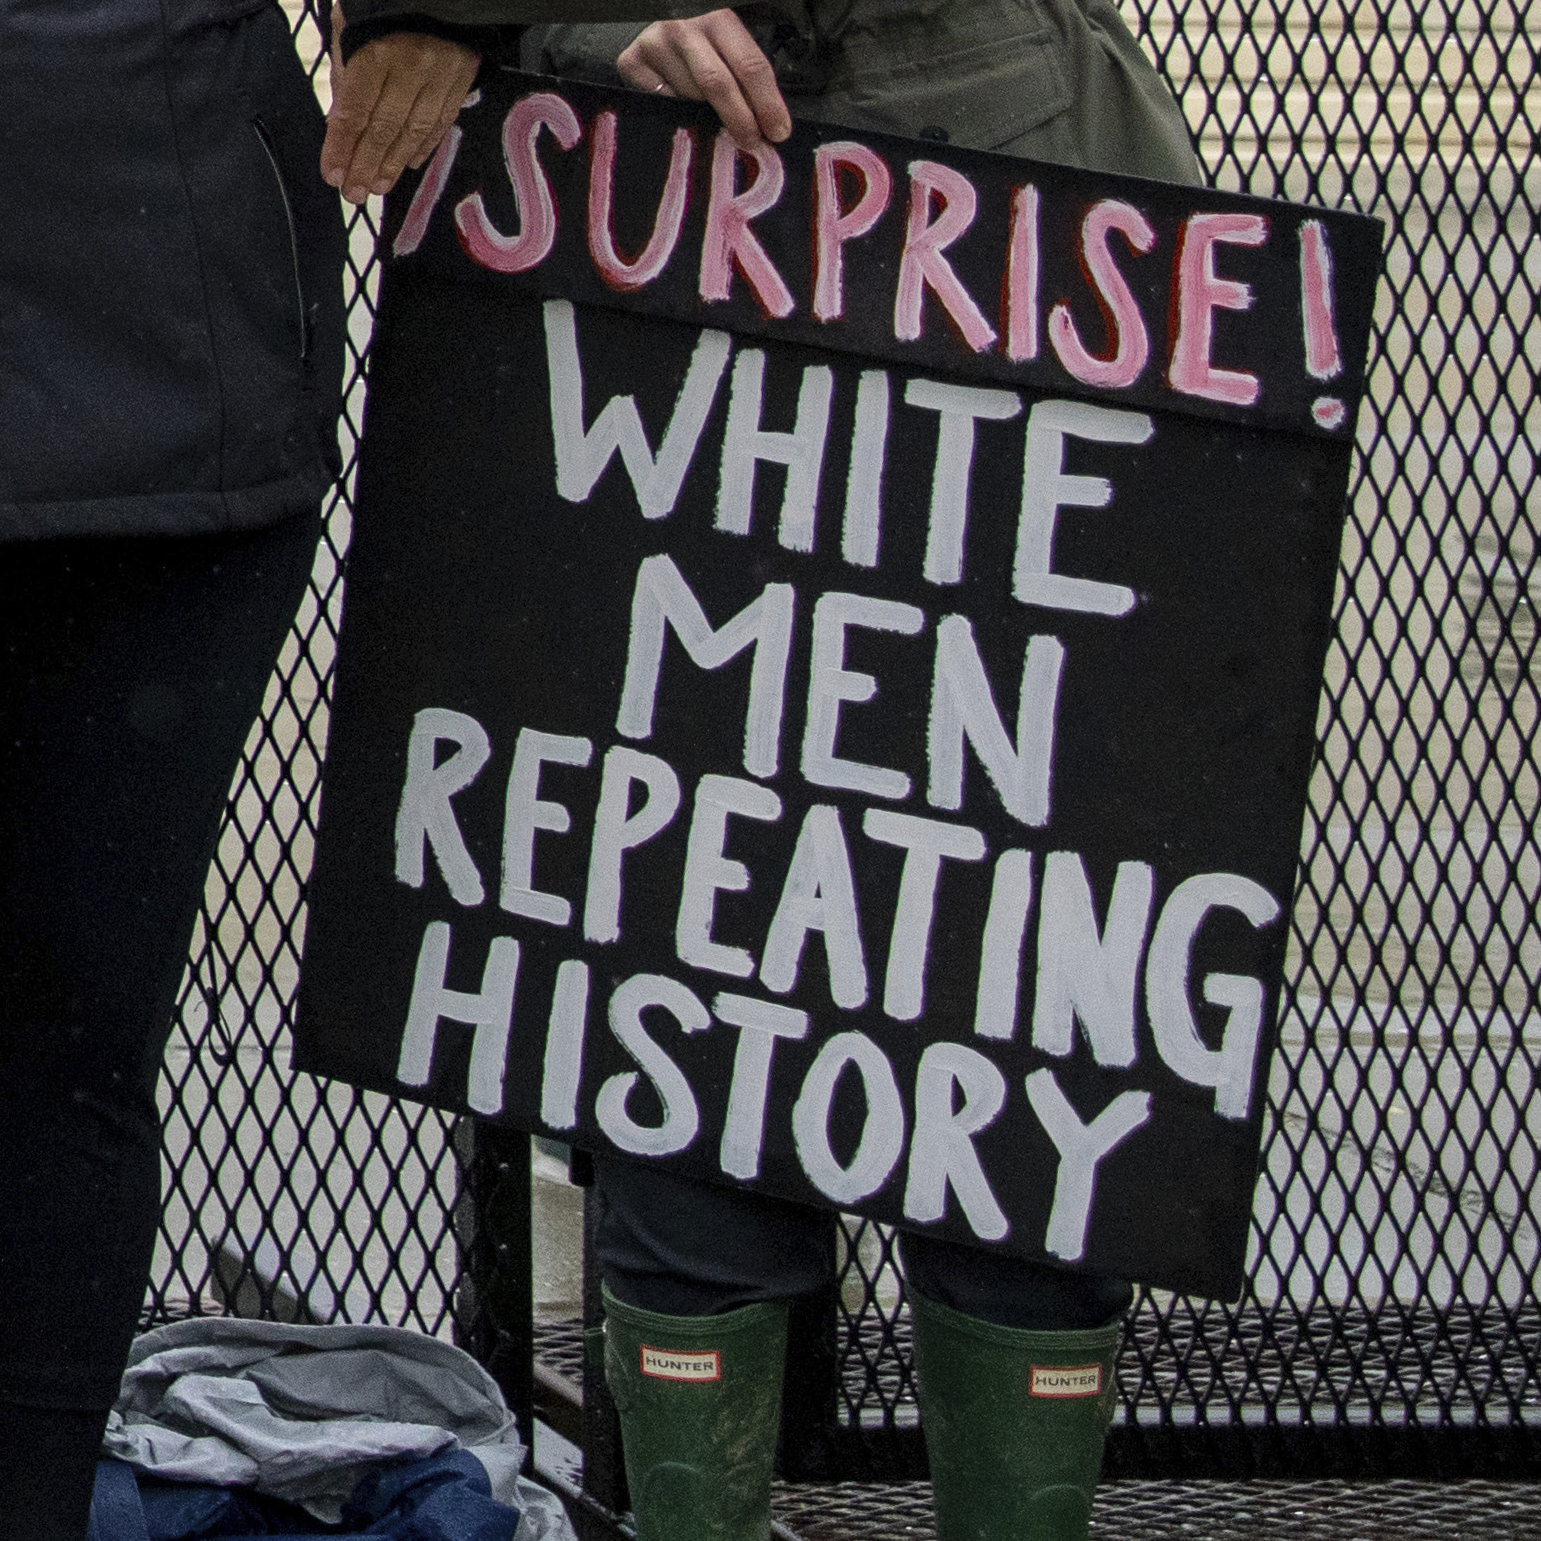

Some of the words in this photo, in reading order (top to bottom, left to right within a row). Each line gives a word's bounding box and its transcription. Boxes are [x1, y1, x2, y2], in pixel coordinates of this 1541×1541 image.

[542, 299, 1154, 617] WHITE
[615, 554, 1064, 827] MEN
[394, 706, 1280, 1119] REPEATING
[396, 919, 1151, 1261] HISTORY
[645, 1356, 714, 1371] HUNTER
[1035, 1375, 1097, 1387] HUNTER
